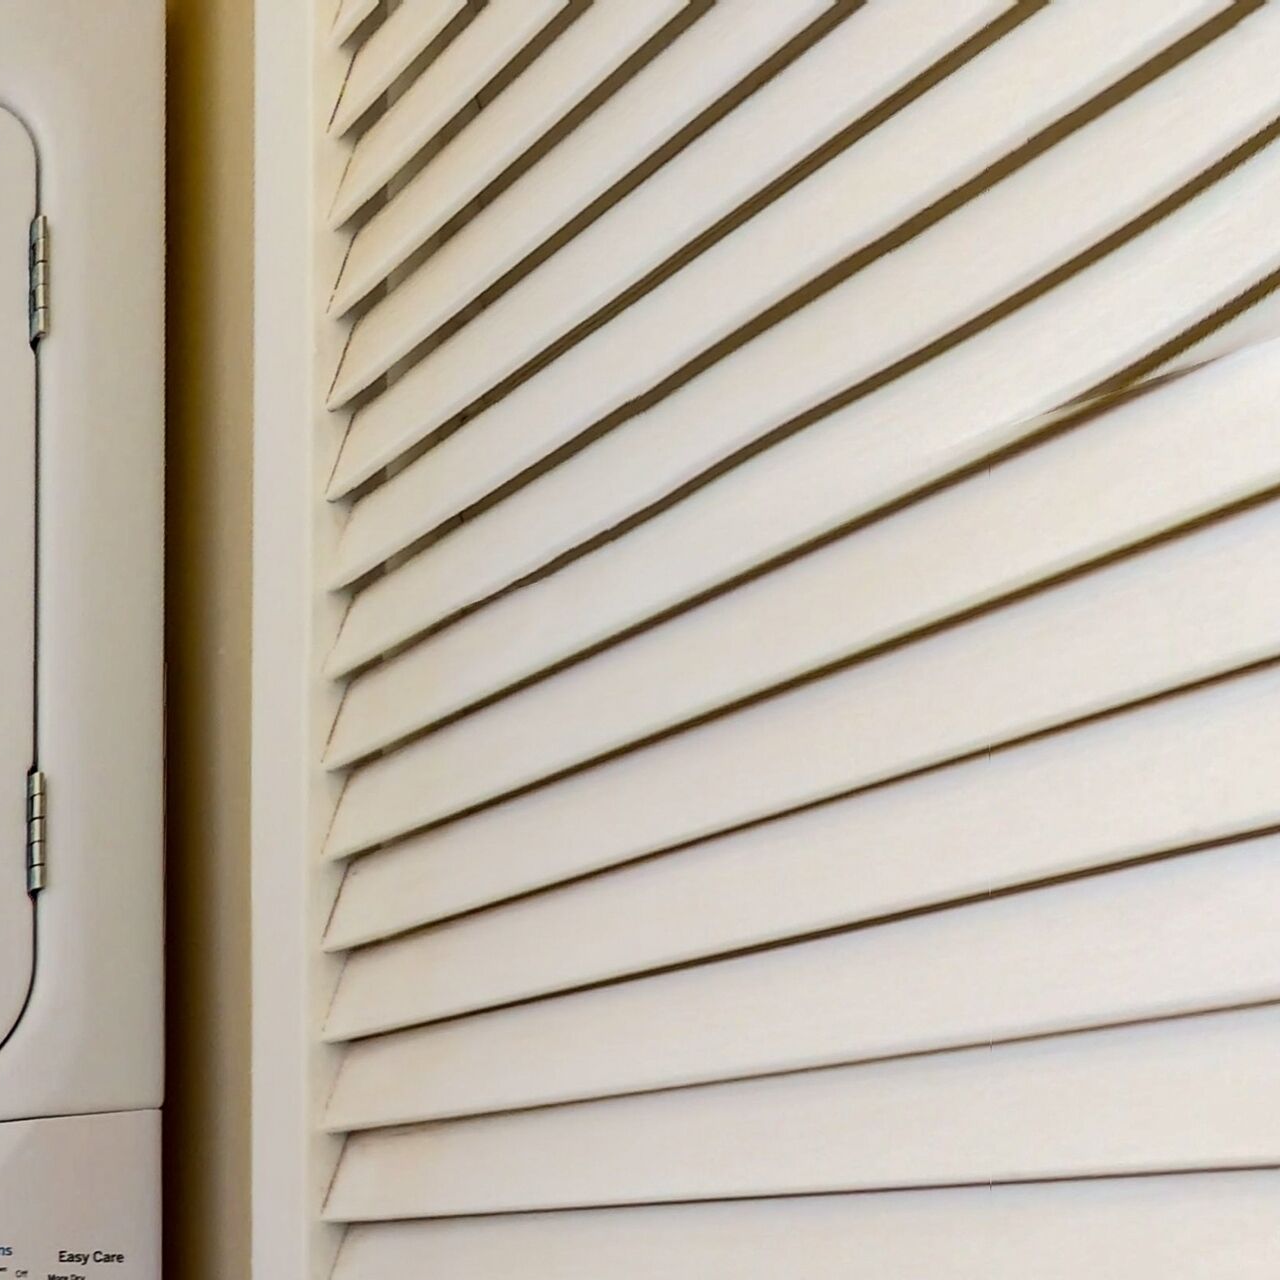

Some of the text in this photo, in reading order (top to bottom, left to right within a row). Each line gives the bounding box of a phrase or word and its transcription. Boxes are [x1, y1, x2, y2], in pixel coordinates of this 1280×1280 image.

[59, 1251, 124, 1265] Easy Care
[16, 1270, 28, 1278] Off
